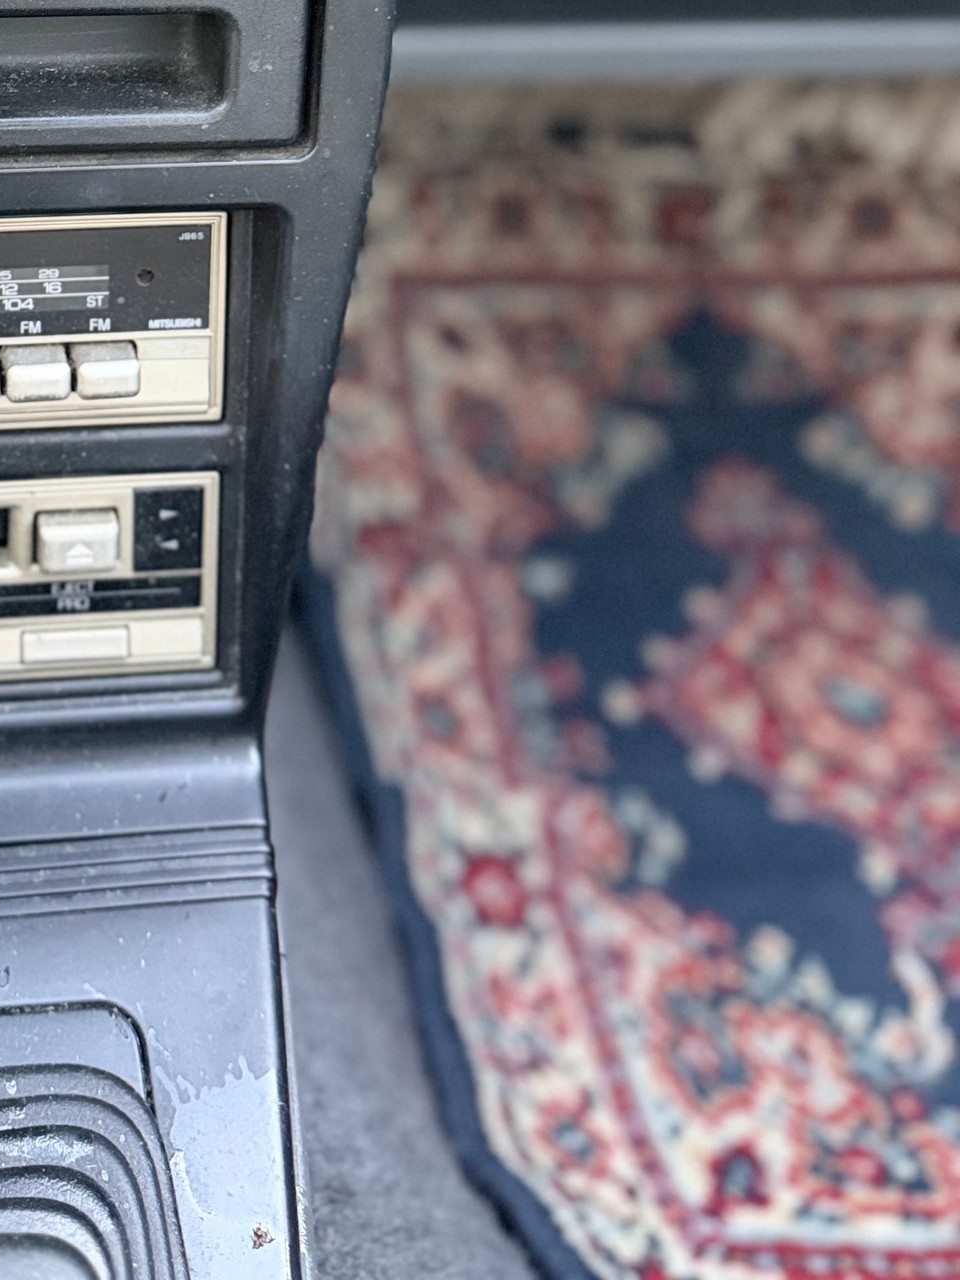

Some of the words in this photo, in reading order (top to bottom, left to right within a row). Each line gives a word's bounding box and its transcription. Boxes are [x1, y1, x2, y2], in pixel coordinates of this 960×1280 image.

[38, 268, 59, 279] 29
[0, 283, 18, 296] 12
[43, 281, 62, 294] 16
[2, 298, 34, 311] 104
[86, 295, 104, 308] ST
[20, 320, 42, 334] FM
[89, 318, 111, 331] FM
[148, 318, 202, 329] MITSUBISHI
